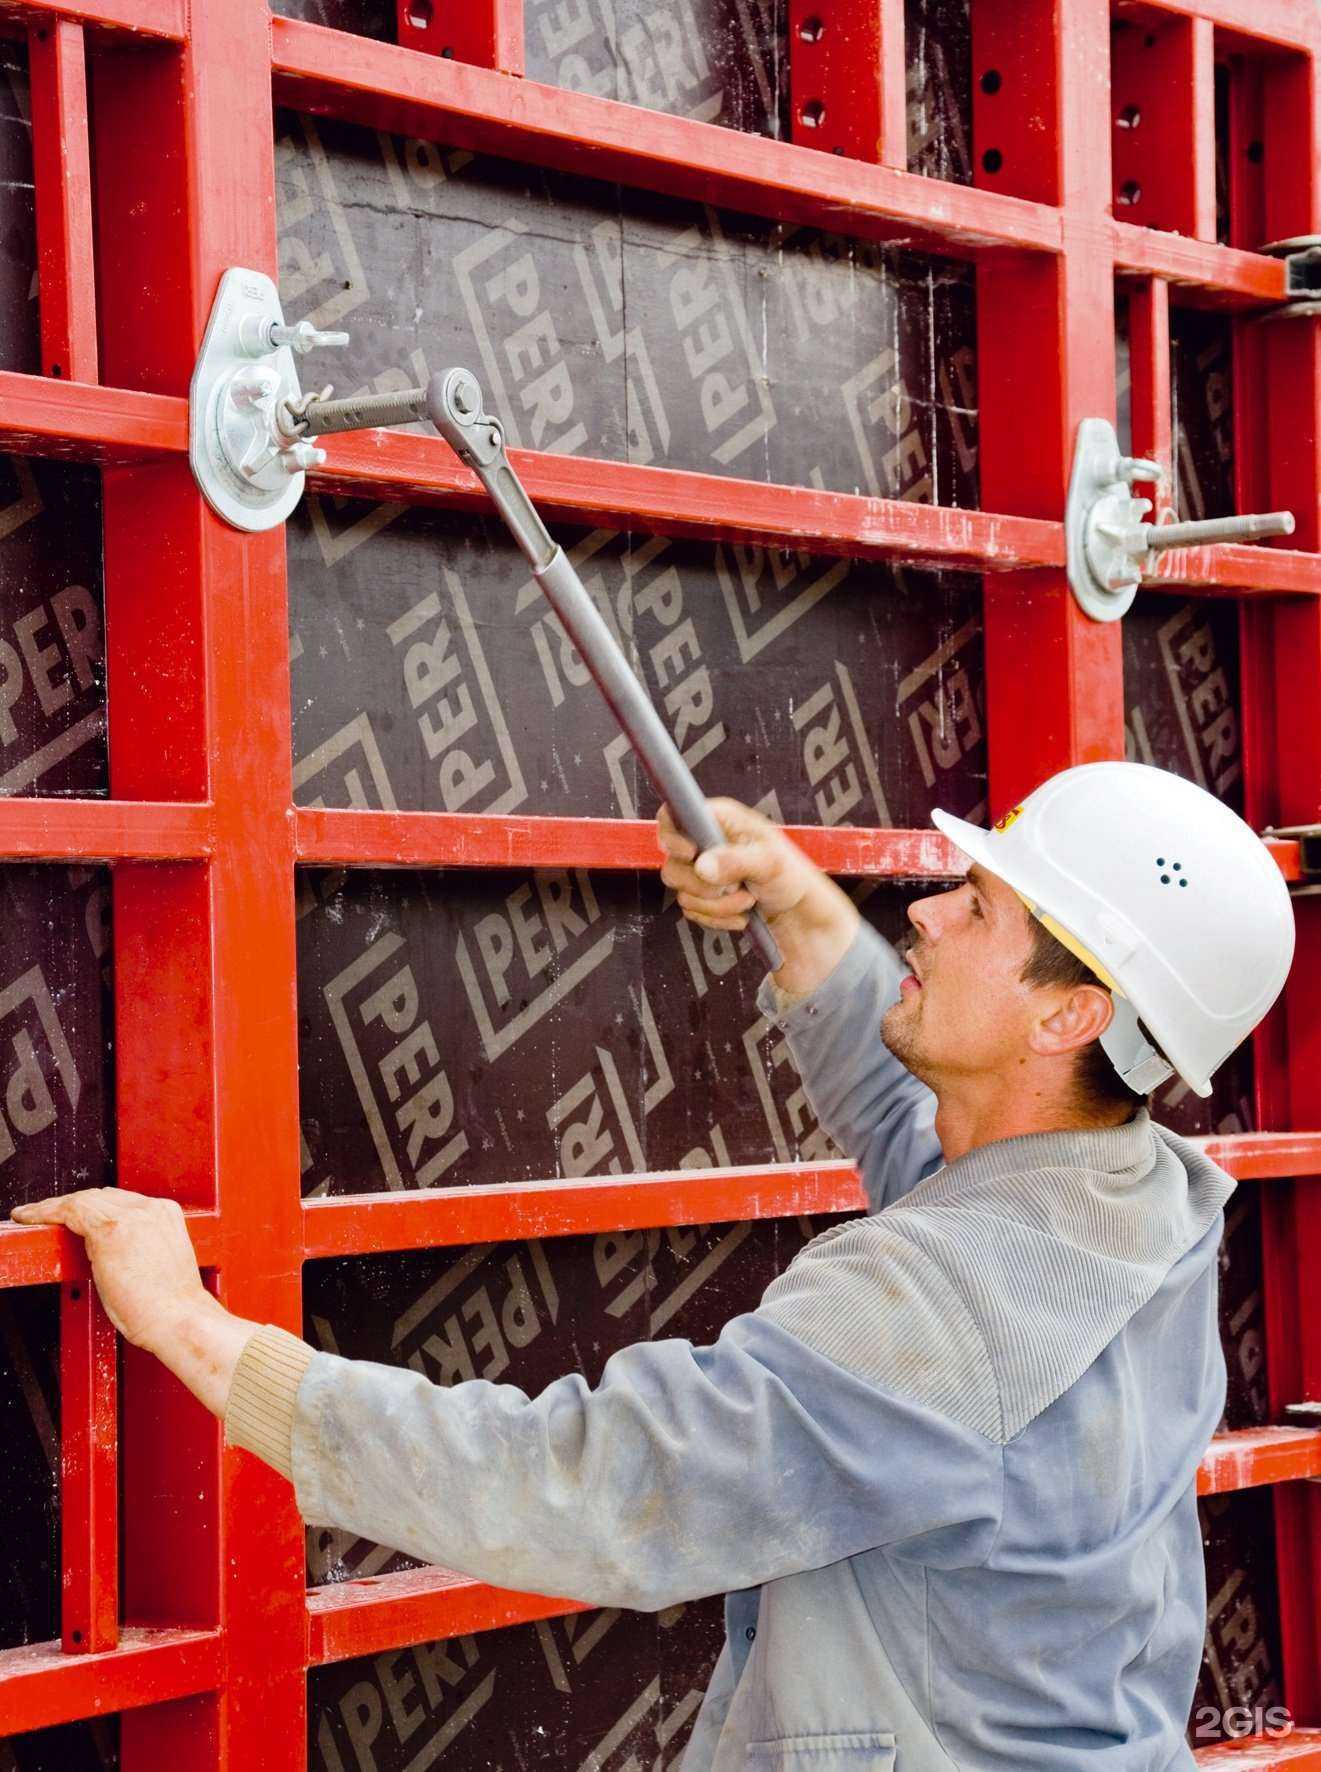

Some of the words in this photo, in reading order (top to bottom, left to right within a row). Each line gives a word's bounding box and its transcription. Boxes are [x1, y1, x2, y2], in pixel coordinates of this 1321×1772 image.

[484, 252, 590, 455] PERI
[657, 228, 750, 434] PERI
[385, 591, 497, 813] PERI
[634, 564, 728, 771] PERI
[791, 682, 863, 828] ERI
[473, 867, 602, 1008] PERI
[358, 964, 471, 1190] PERI
